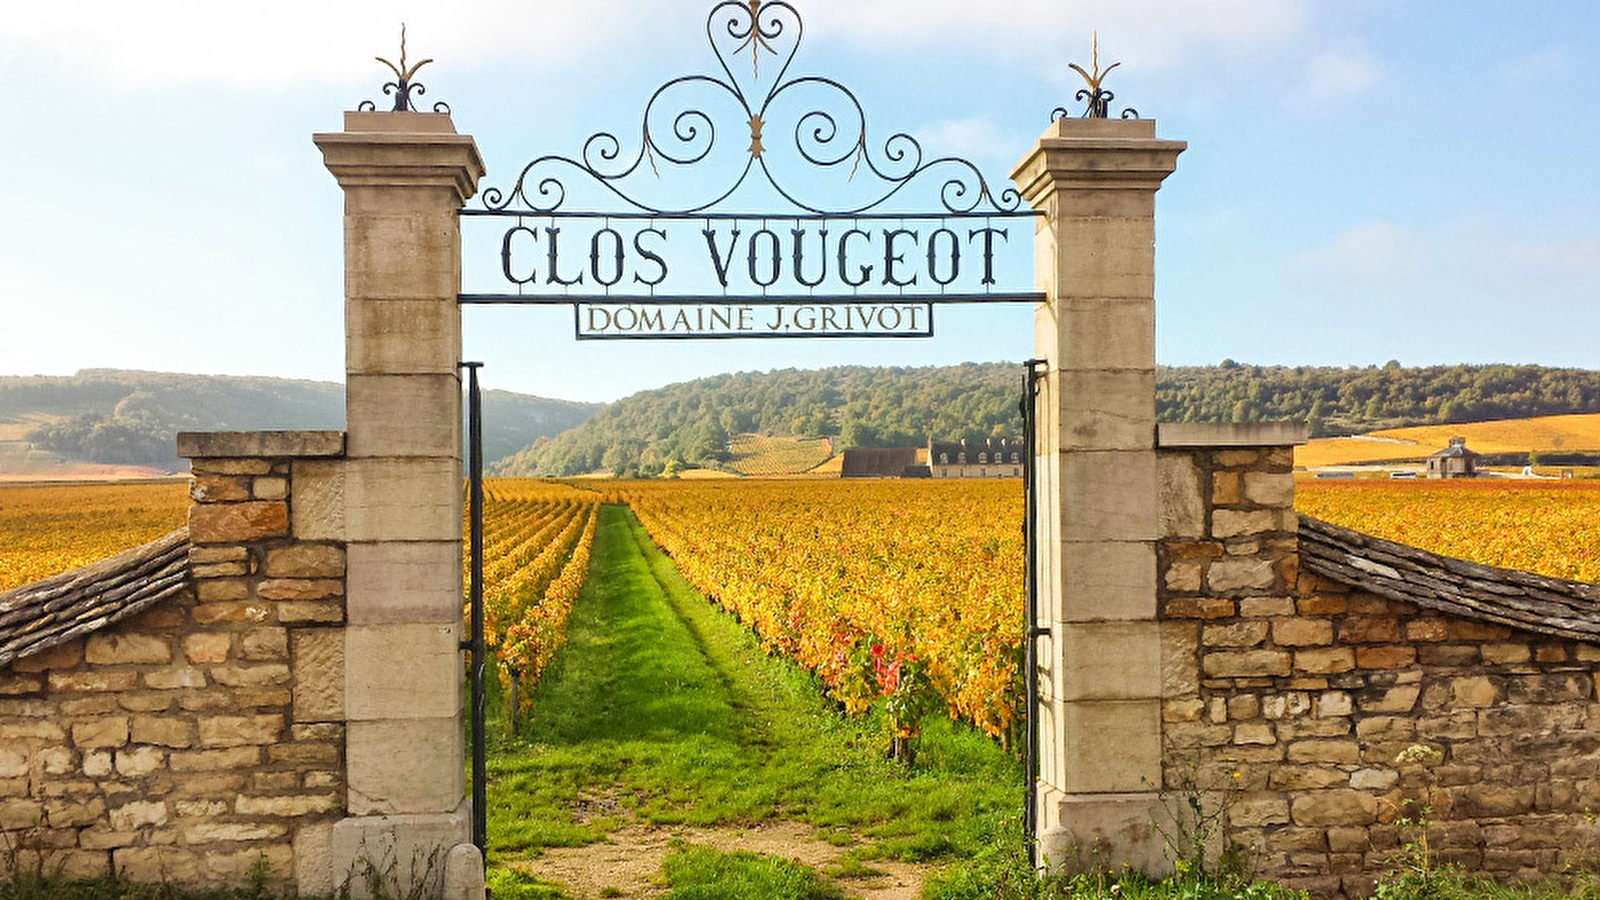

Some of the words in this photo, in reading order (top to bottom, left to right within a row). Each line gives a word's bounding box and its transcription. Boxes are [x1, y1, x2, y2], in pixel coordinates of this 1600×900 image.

[501, 226, 668, 286] CLOS
[702, 227, 1009, 287] VOUGEOT
[587, 306, 753, 331] DOMAINE
